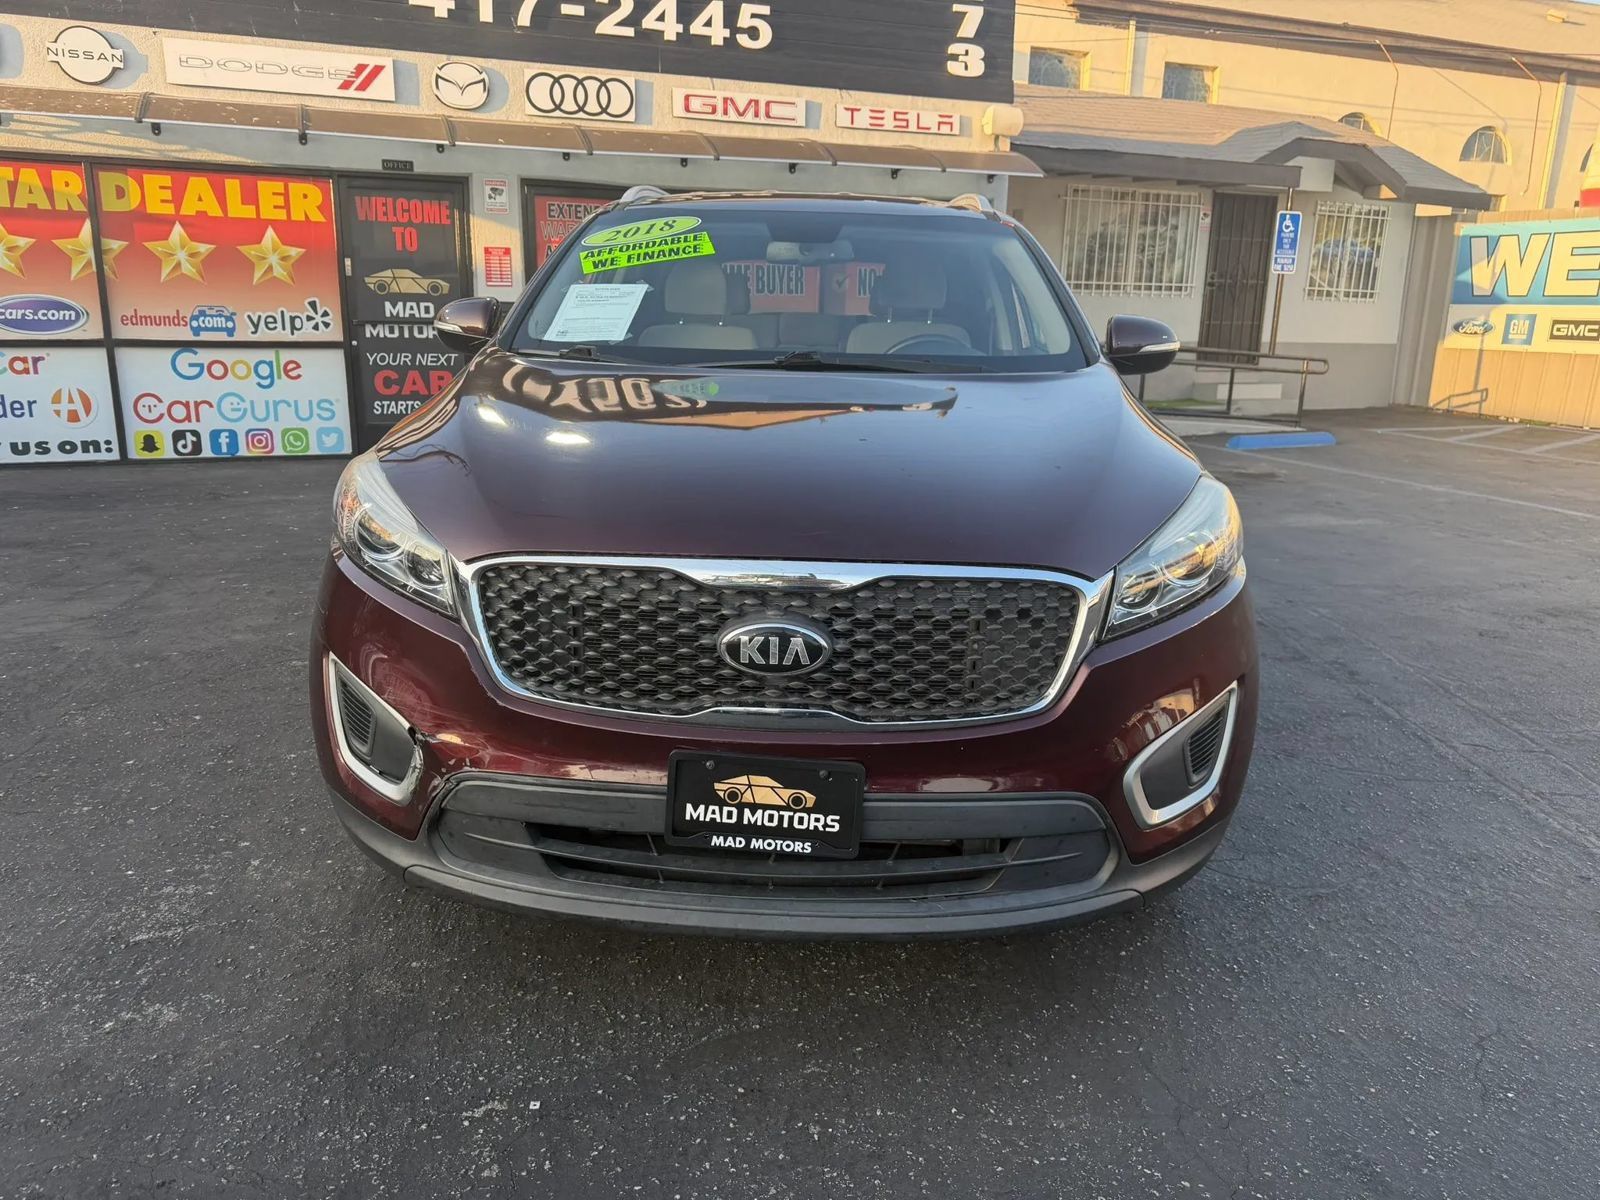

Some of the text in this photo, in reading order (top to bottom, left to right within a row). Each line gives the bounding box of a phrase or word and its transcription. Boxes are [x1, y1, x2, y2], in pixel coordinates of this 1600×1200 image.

[46, 46, 123, 64] NISSAN
[178, 54, 358, 81] DODGE
[683, 93, 797, 122] GMC
[843, 106, 955, 132] TESLA
[383, 160, 412, 169] OFFICE
[98, 170, 327, 223] DEALER
[355, 195, 452, 225] WELCOME
[392, 226, 419, 252] TO
[603, 219, 677, 243] 2018
[583, 233, 703, 260] AFFORDABLE
[592, 244, 702, 270] WE FINANCE
[1470, 229, 1600, 298] WE
[754, 263, 805, 297] BUYER
[120, 308, 188, 328] edmunds
[246, 309, 304, 336] yelp
[384, 301, 436, 318] MAD
[1458, 318, 1489, 335] Ford
[1509, 319, 1530, 335] GM
[1552, 323, 1600, 337] GMC
[170, 347, 303, 390] Google
[366, 352, 459, 366] YOUR NEXT
[374, 369, 454, 396] CAR
[132, 391, 337, 424] CarGurus
[9, 439, 114, 456] us on:
[738, 635, 811, 665] KIA
[685, 802, 841, 833] MAD MOTORS
[710, 835, 812, 854] MAD MOTORS
